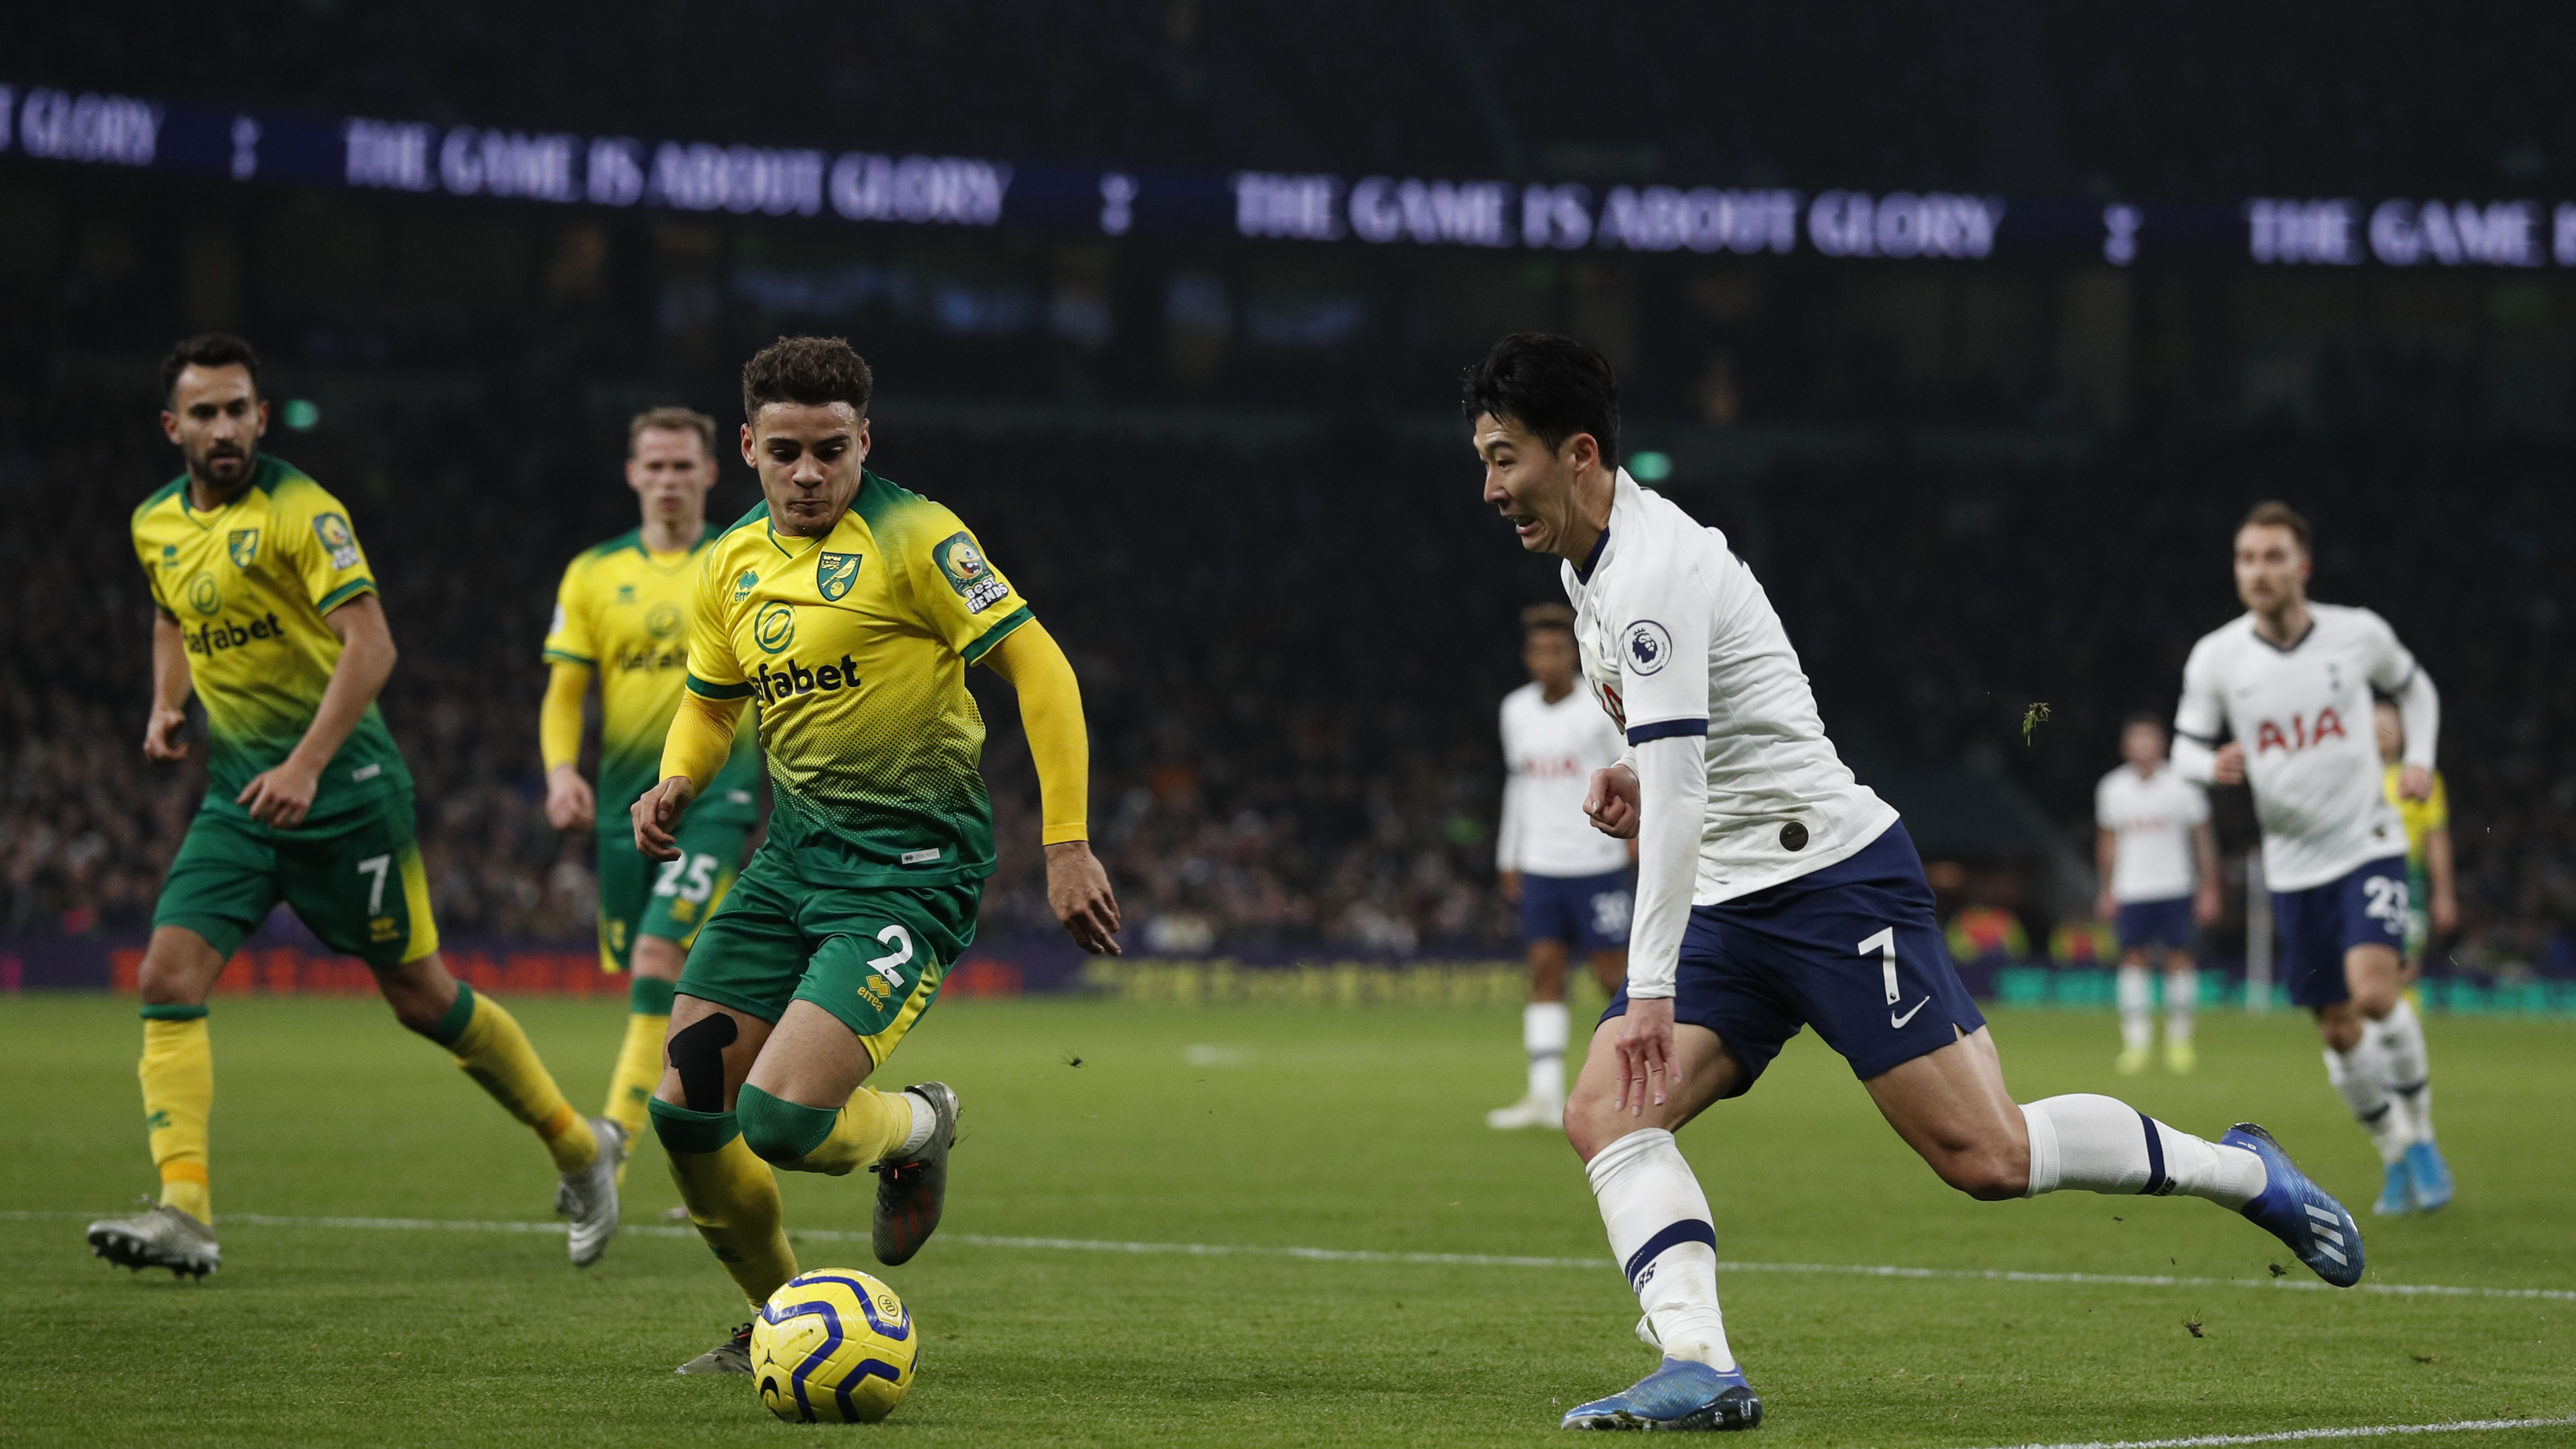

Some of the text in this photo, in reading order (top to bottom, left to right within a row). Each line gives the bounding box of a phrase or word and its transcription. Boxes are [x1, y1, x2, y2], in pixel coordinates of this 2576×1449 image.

[343, 117, 435, 189] THE
[438, 126, 578, 201] GAME
[648, 140, 823, 215] ABOUT
[829, 151, 1012, 225] GLORY
[1232, 171, 2003, 258] THE GAME IS ABOUT GLORY
[2243, 198, 2363, 264] THE
[2368, 199, 2545, 266] GAME
[184, 613, 283, 657] afabet
[746, 654, 861, 706] afabet
[2258, 708, 2346, 755] AIA
[357, 853, 391, 916] 7
[653, 848, 719, 904] 25
[866, 925, 913, 988] 2
[1858, 926, 1900, 1005] 7
[857, 987, 884, 1013] errea
